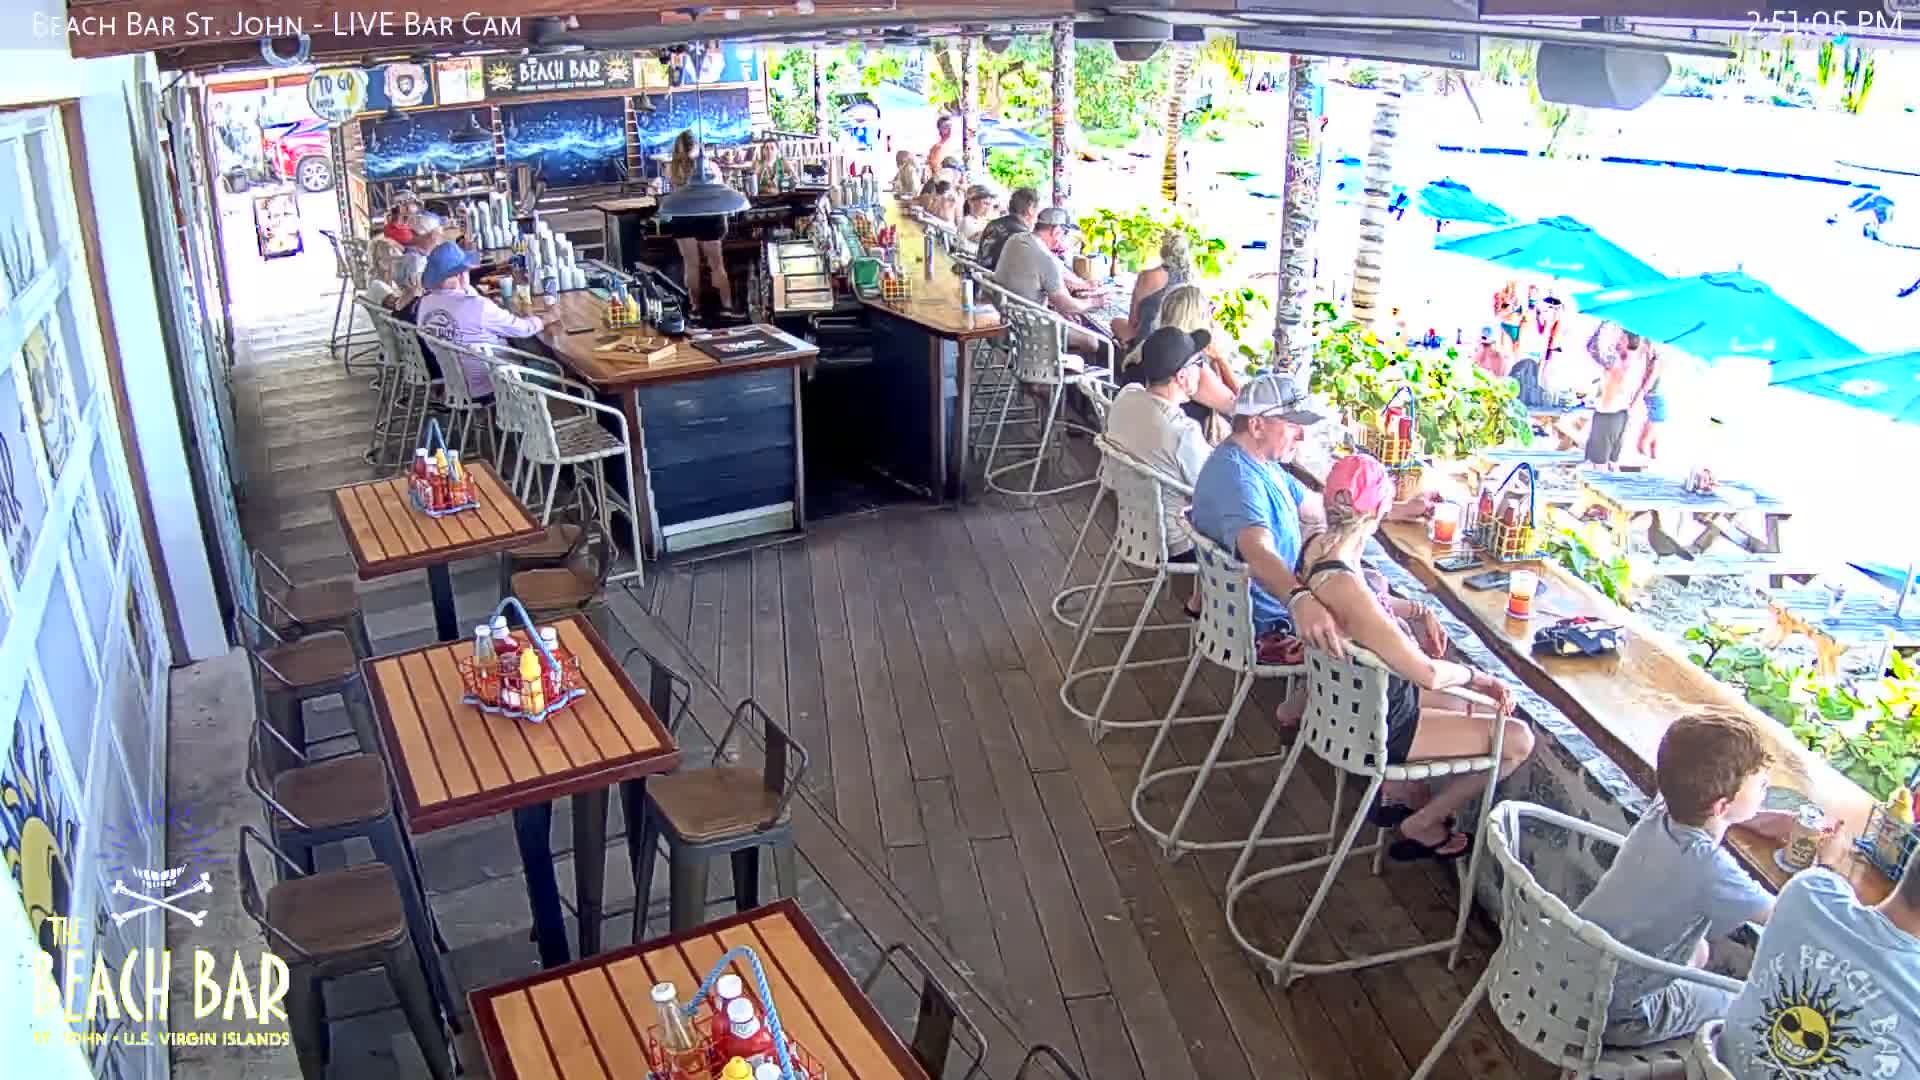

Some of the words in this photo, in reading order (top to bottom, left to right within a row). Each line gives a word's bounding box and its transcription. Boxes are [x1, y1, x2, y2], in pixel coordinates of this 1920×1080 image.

[519, 59, 564, 83] BEACH
[569, 58, 601, 80] BAR
[314, 75, 333, 97] TO
[1799, 943, 1884, 1005] BEACH
